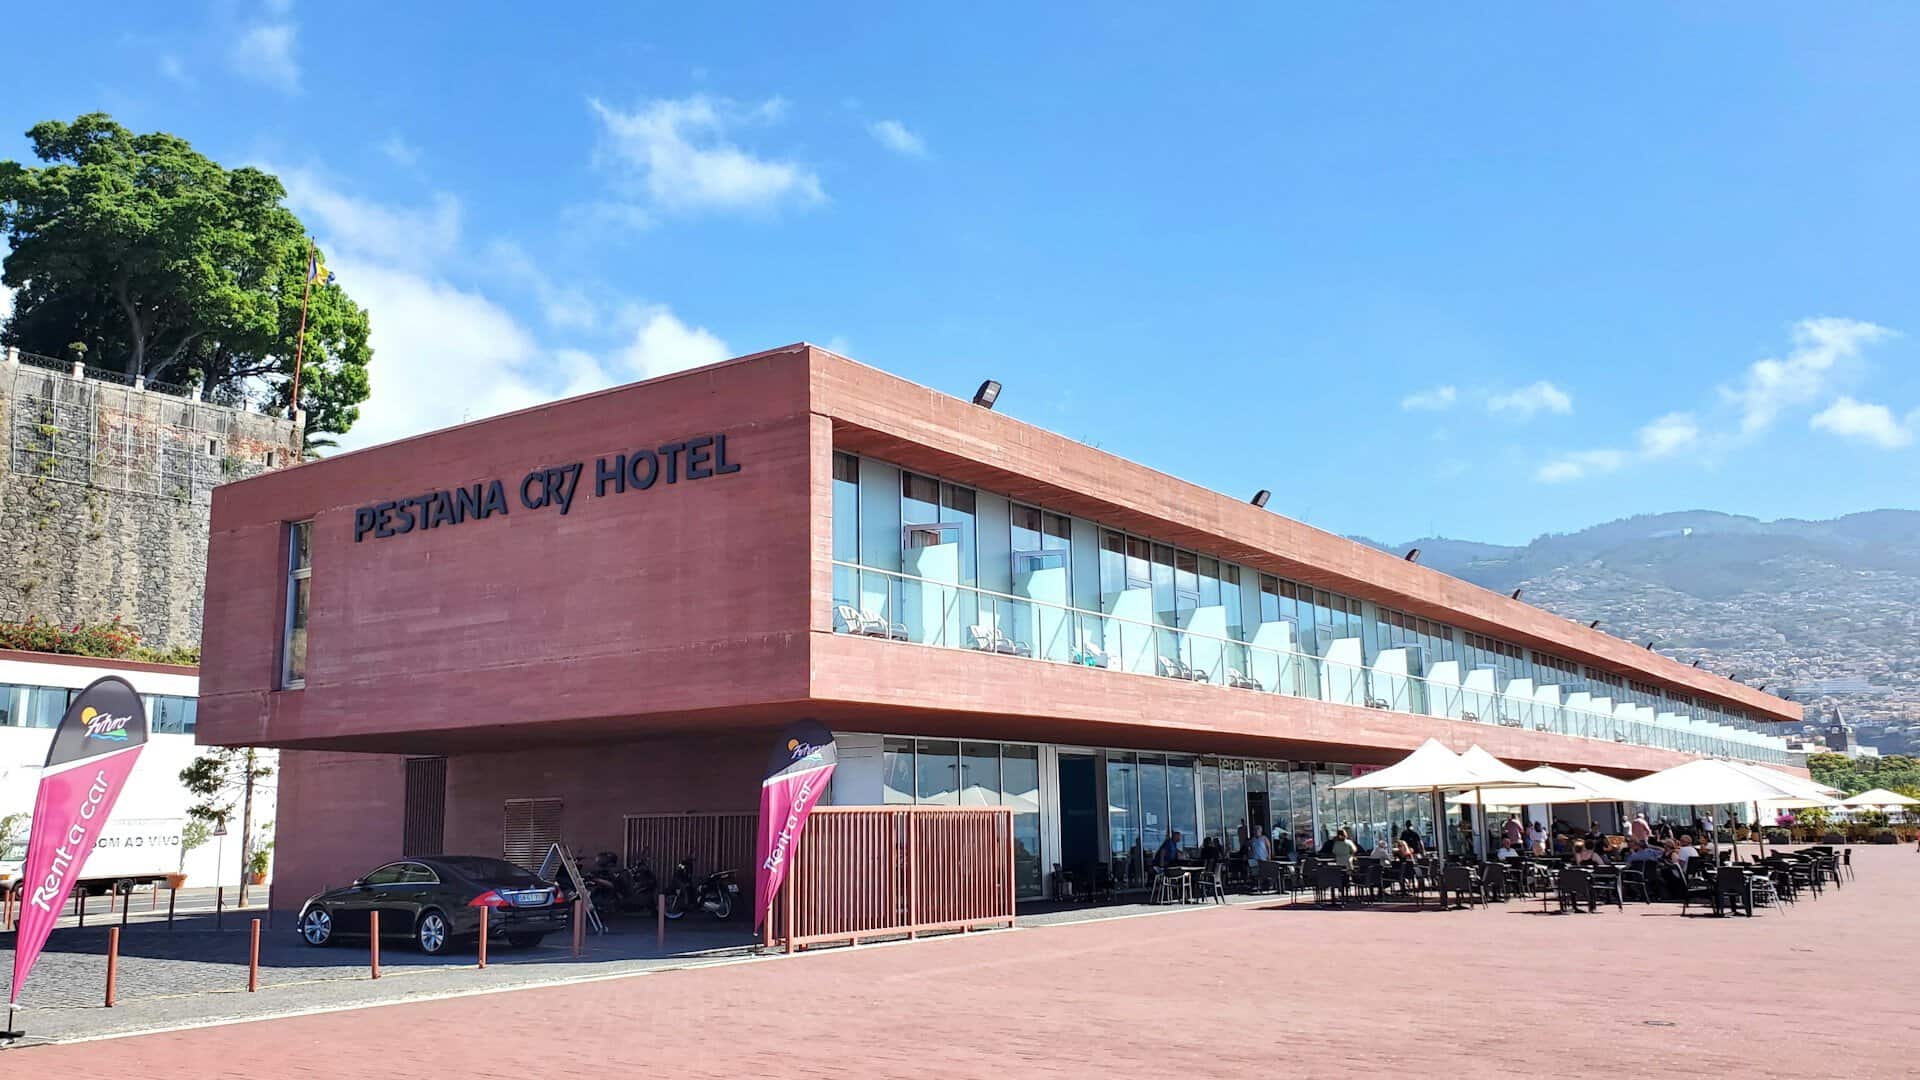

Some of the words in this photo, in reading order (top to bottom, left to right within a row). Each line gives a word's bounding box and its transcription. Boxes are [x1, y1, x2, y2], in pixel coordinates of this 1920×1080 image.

[354, 480, 508, 542] PESTANA
[520, 463, 583, 515] CR7
[595, 433, 741, 497] HOTEL
[31, 845, 73, 912] Rent
[69, 824, 85, 845] a
[80, 770, 108, 820] car
[763, 829, 792, 873] Rent
[787, 815, 799, 830] a
[794, 782, 812, 812] car
